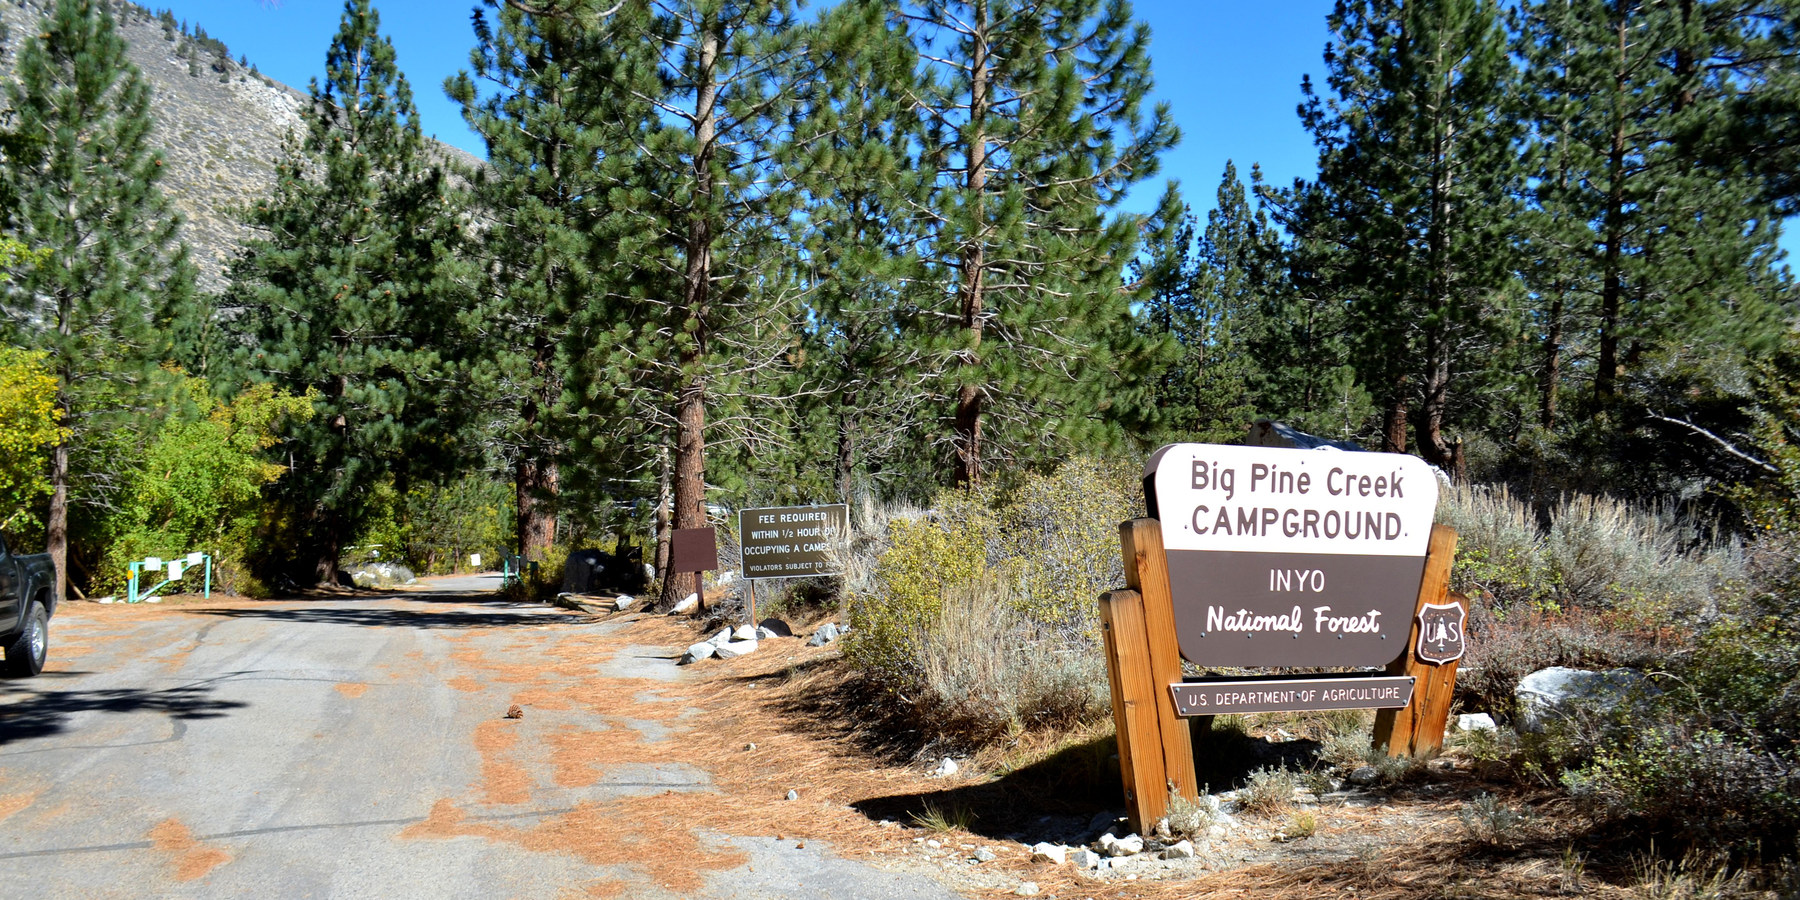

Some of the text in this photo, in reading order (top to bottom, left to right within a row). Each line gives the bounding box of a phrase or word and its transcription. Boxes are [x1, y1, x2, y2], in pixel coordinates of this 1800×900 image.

[1191, 460, 1404, 501] Big Pine Creek
[758, 512, 827, 524] FEE REQUIRED
[1191, 505, 1402, 541] CAMPGROUND
[751, 529, 779, 539] WITHIN
[797, 528, 820, 537] HOUR
[744, 543, 844, 556] OCCUPYING A CAMPS
[750, 564, 783, 572] VIOLATORS
[785, 562, 812, 570] SUBJECT
[1269, 569, 1326, 593] INYO
[1206, 605, 1382, 633] National Forest
[1189, 687, 1400, 707] U.S. DEPARTMENT OF AGRICULTURE
